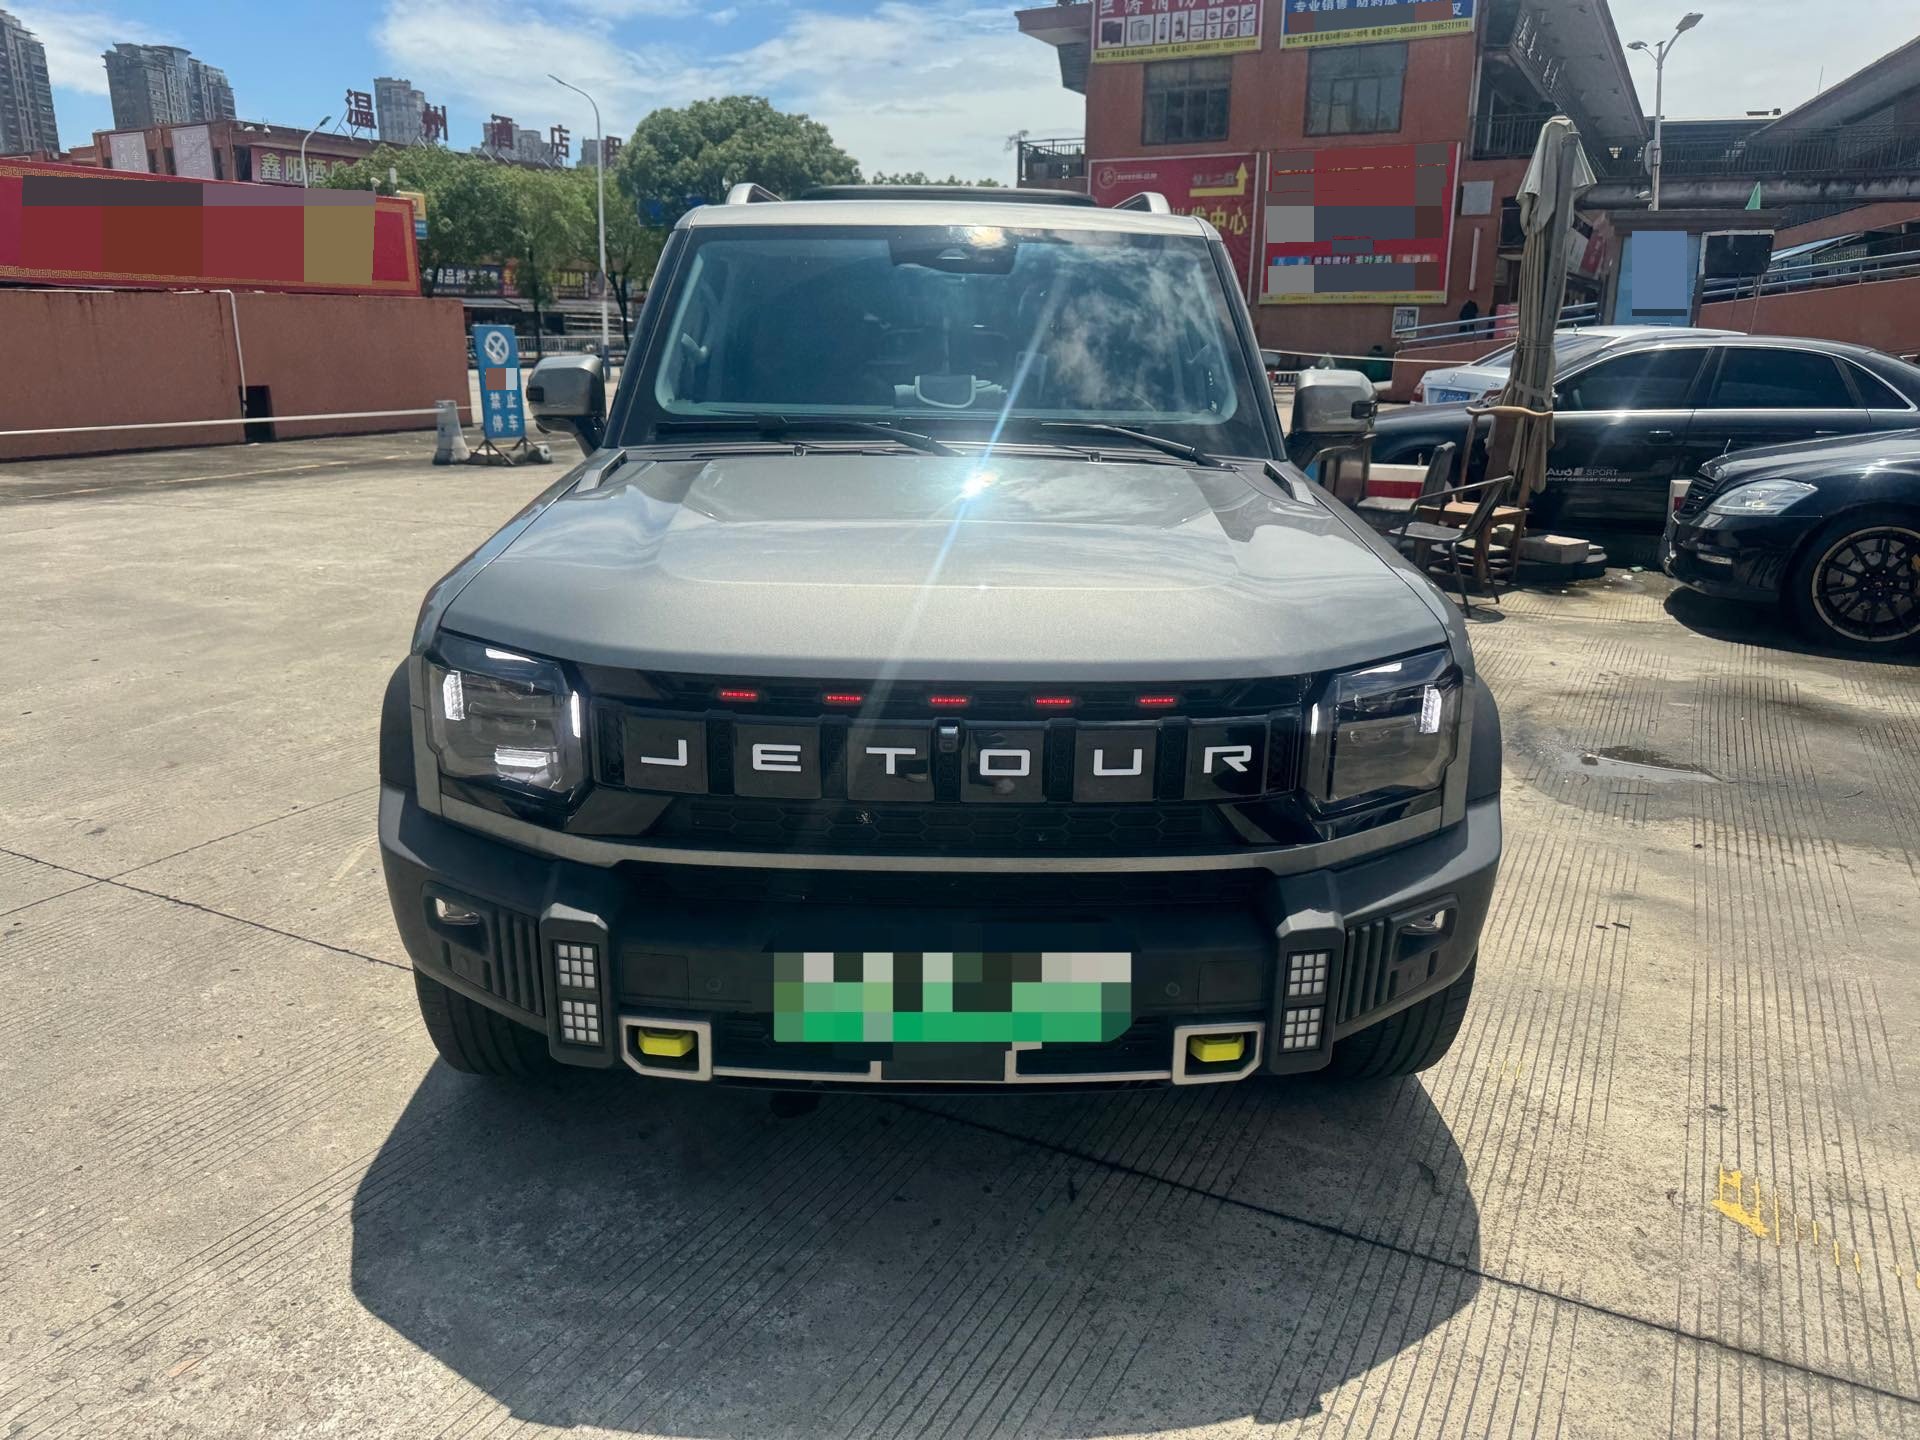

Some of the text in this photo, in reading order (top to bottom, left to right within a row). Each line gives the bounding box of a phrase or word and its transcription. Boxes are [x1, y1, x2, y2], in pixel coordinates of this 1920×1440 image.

[489, 391, 518, 410] 禁止
[491, 414, 519, 433] 停车
[640, 739, 1252, 777] JETOUR
